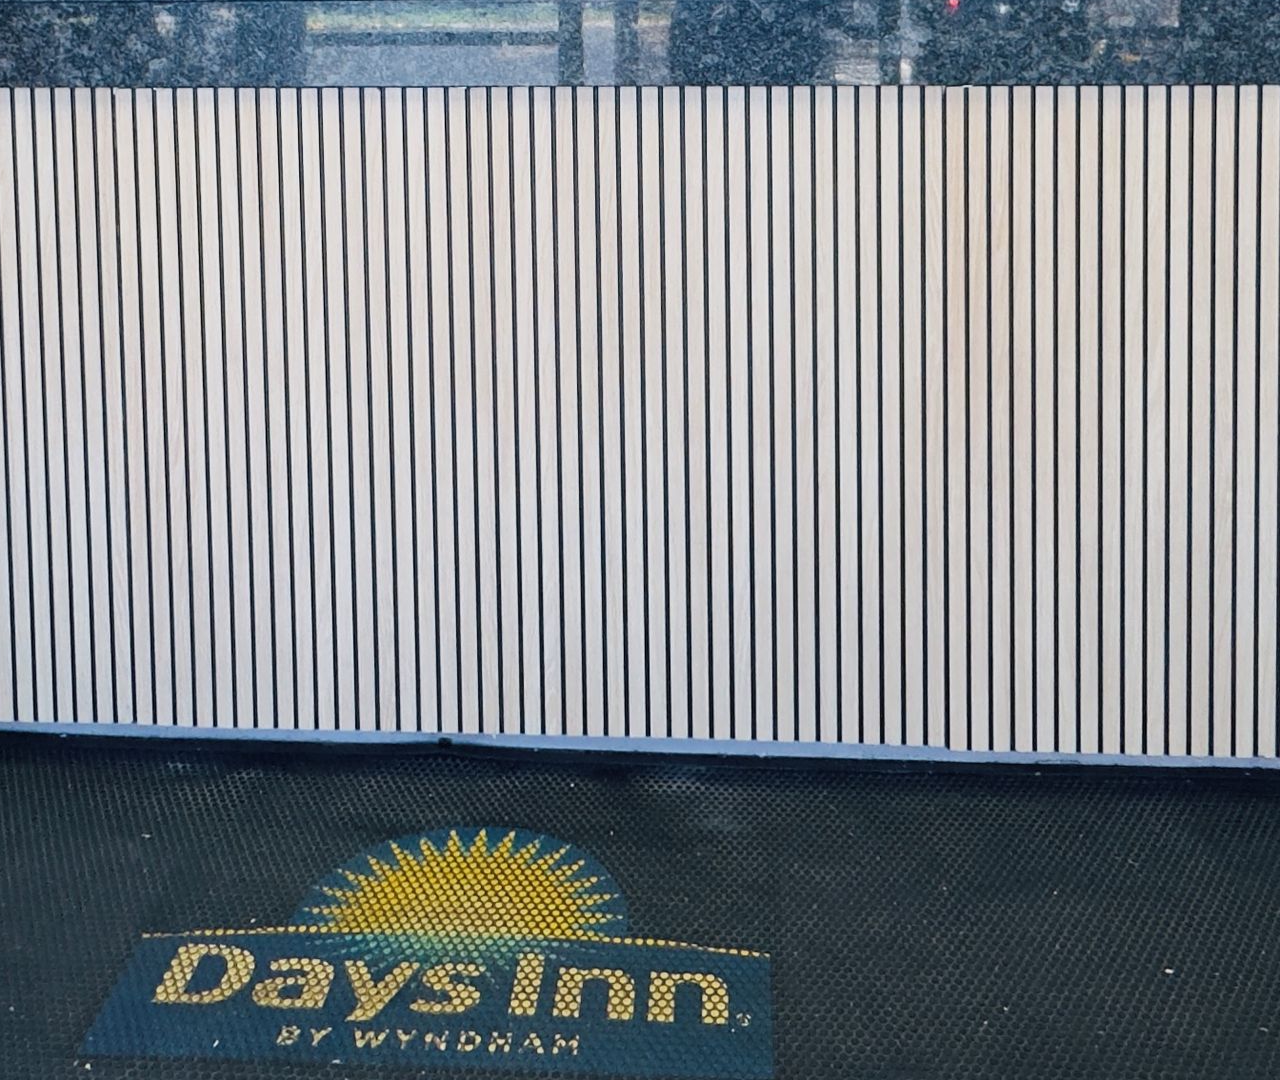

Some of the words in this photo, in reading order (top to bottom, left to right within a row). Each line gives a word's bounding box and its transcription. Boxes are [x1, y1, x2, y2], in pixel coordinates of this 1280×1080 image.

[151, 943, 485, 1021] Days
[509, 952, 729, 1024] Inn
[276, 1026, 332, 1046] BY
[354, 1028, 580, 1056] WYNDHAM
